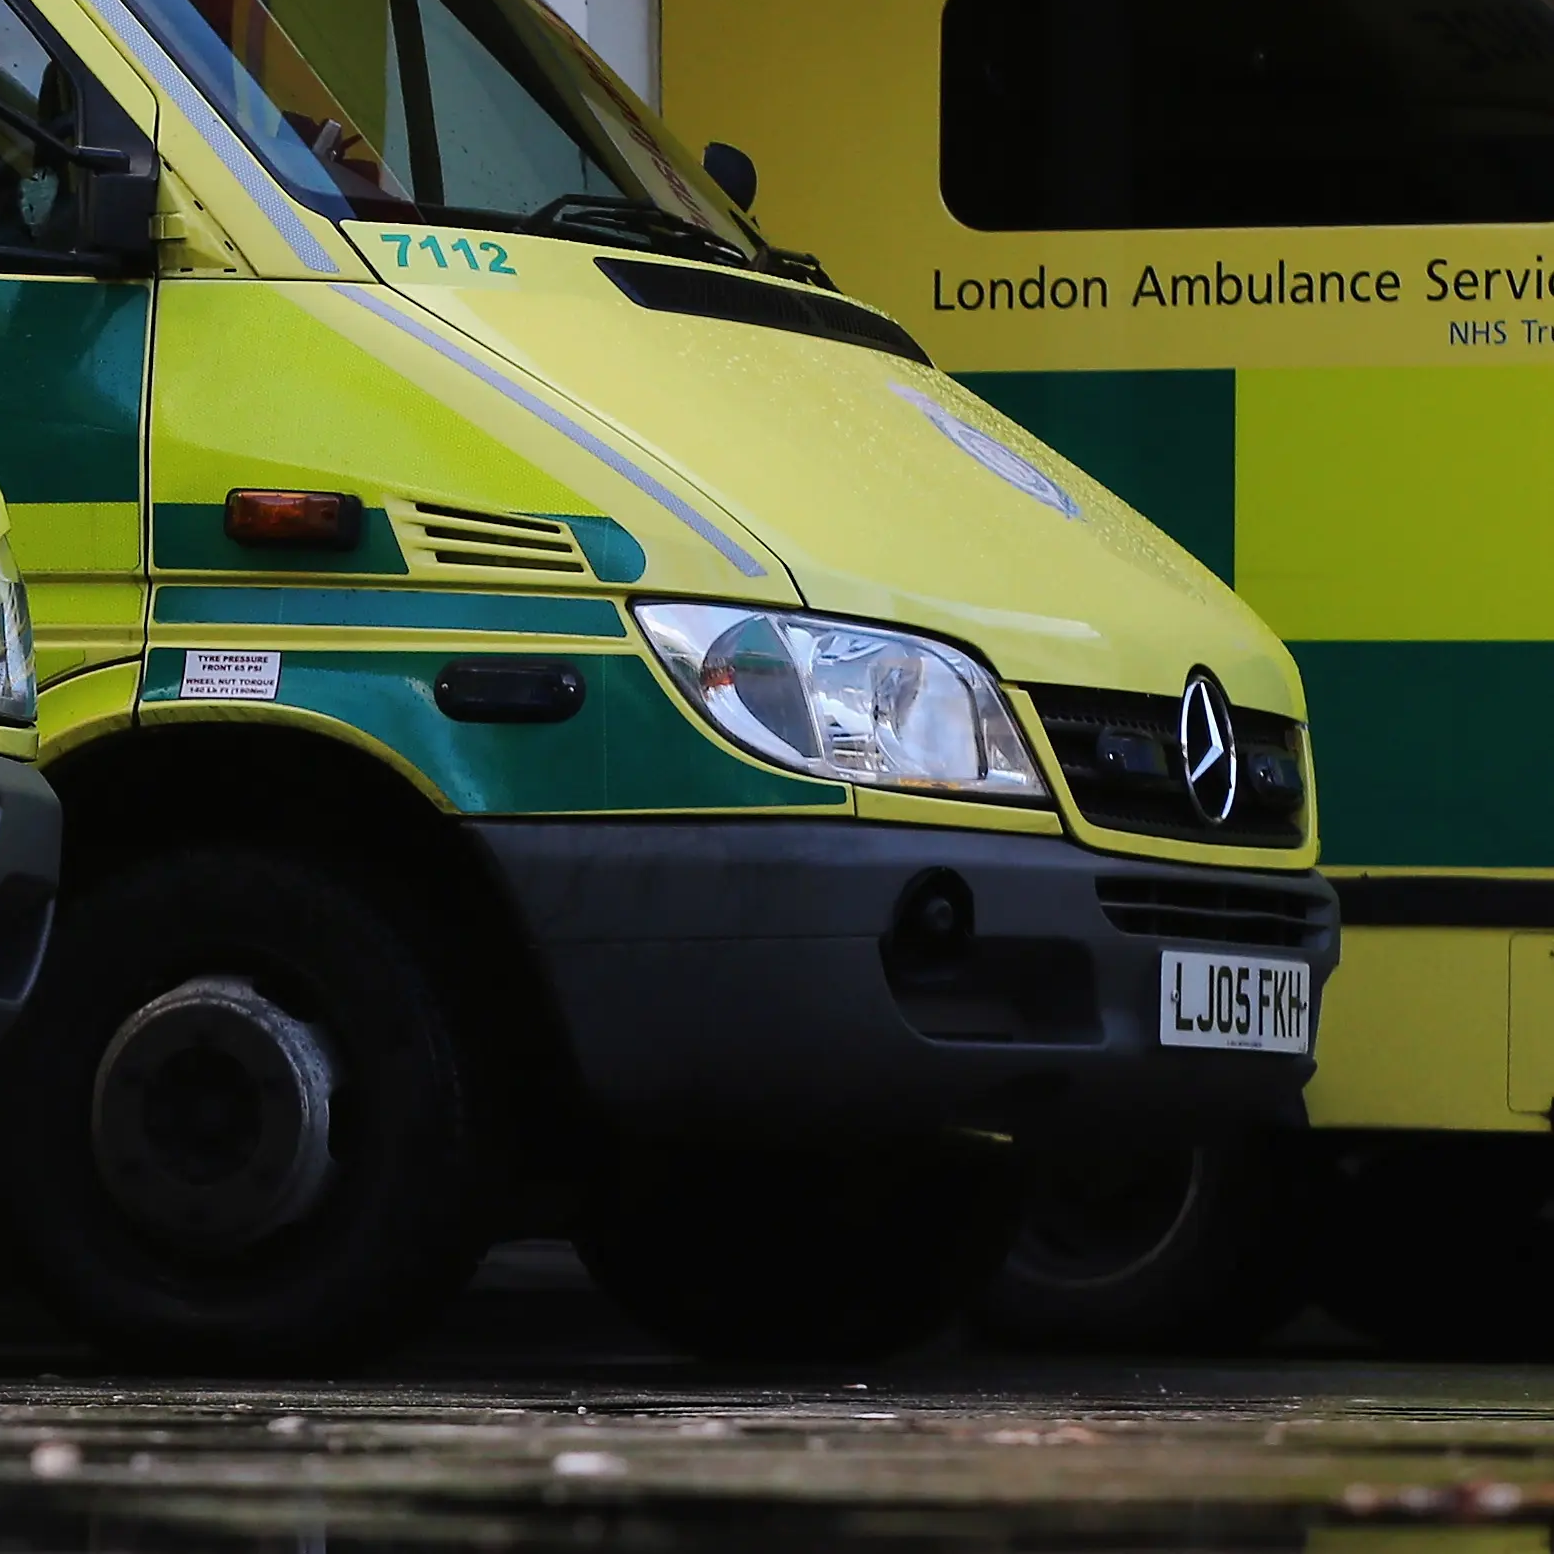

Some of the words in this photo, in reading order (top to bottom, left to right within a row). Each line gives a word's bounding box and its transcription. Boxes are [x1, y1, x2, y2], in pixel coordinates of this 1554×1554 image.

[380, 234, 517, 276] 7112
[934, 264, 1109, 312] London
[1131, 259, 1401, 307] Ambulance
[1449, 320, 1507, 345] NHS
[198, 655, 220, 663] TYRE
[223, 655, 269, 663] PRESSURE
[202, 664, 232, 672] FRONT
[1175, 961, 1251, 1036] LJ05
[1258, 967, 1301, 1038] FKH
